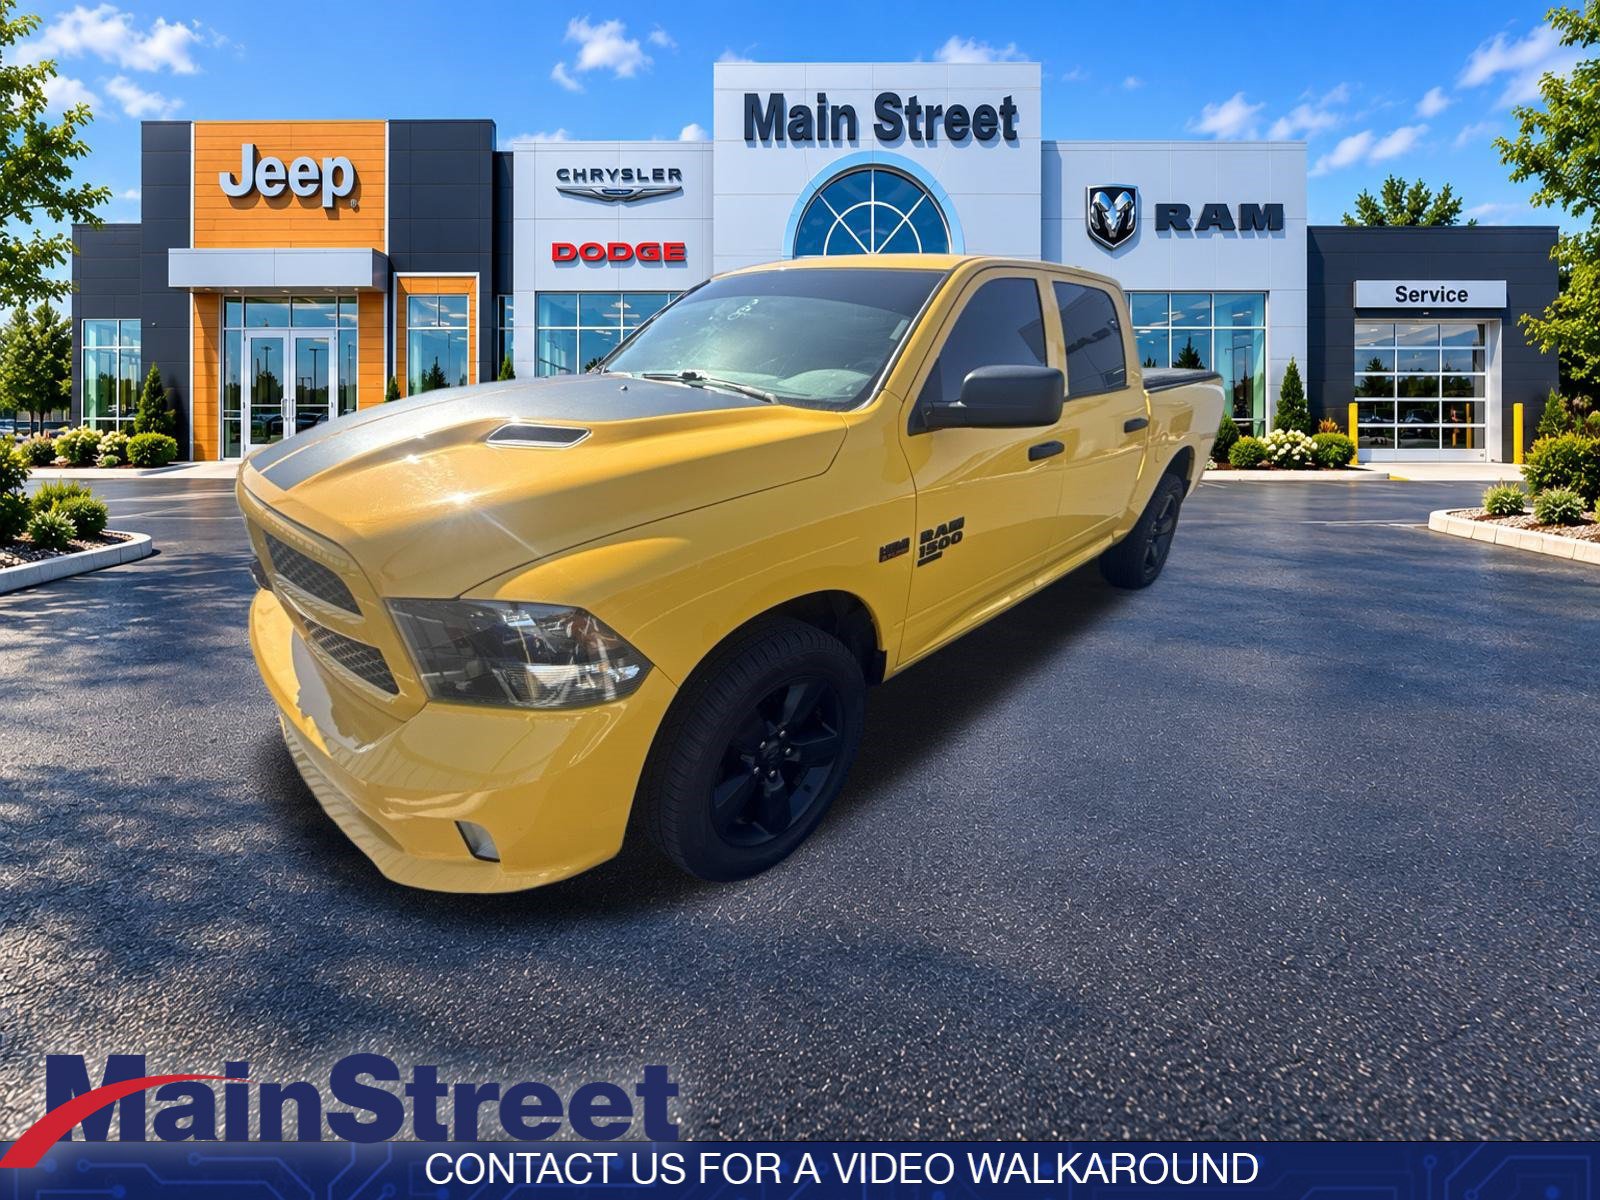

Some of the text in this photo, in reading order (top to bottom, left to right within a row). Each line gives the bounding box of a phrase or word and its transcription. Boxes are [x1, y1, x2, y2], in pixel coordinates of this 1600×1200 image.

[744, 92, 1018, 141] Main Street
[219, 143, 355, 208] Jeep
[556, 168, 683, 183] CHRYSLER
[1155, 203, 1284, 232] RAM
[551, 242, 686, 262] DODGE
[1395, 285, 1469, 303] Service
[920, 516, 965, 544] RAM
[919, 531, 963, 559] 1500
